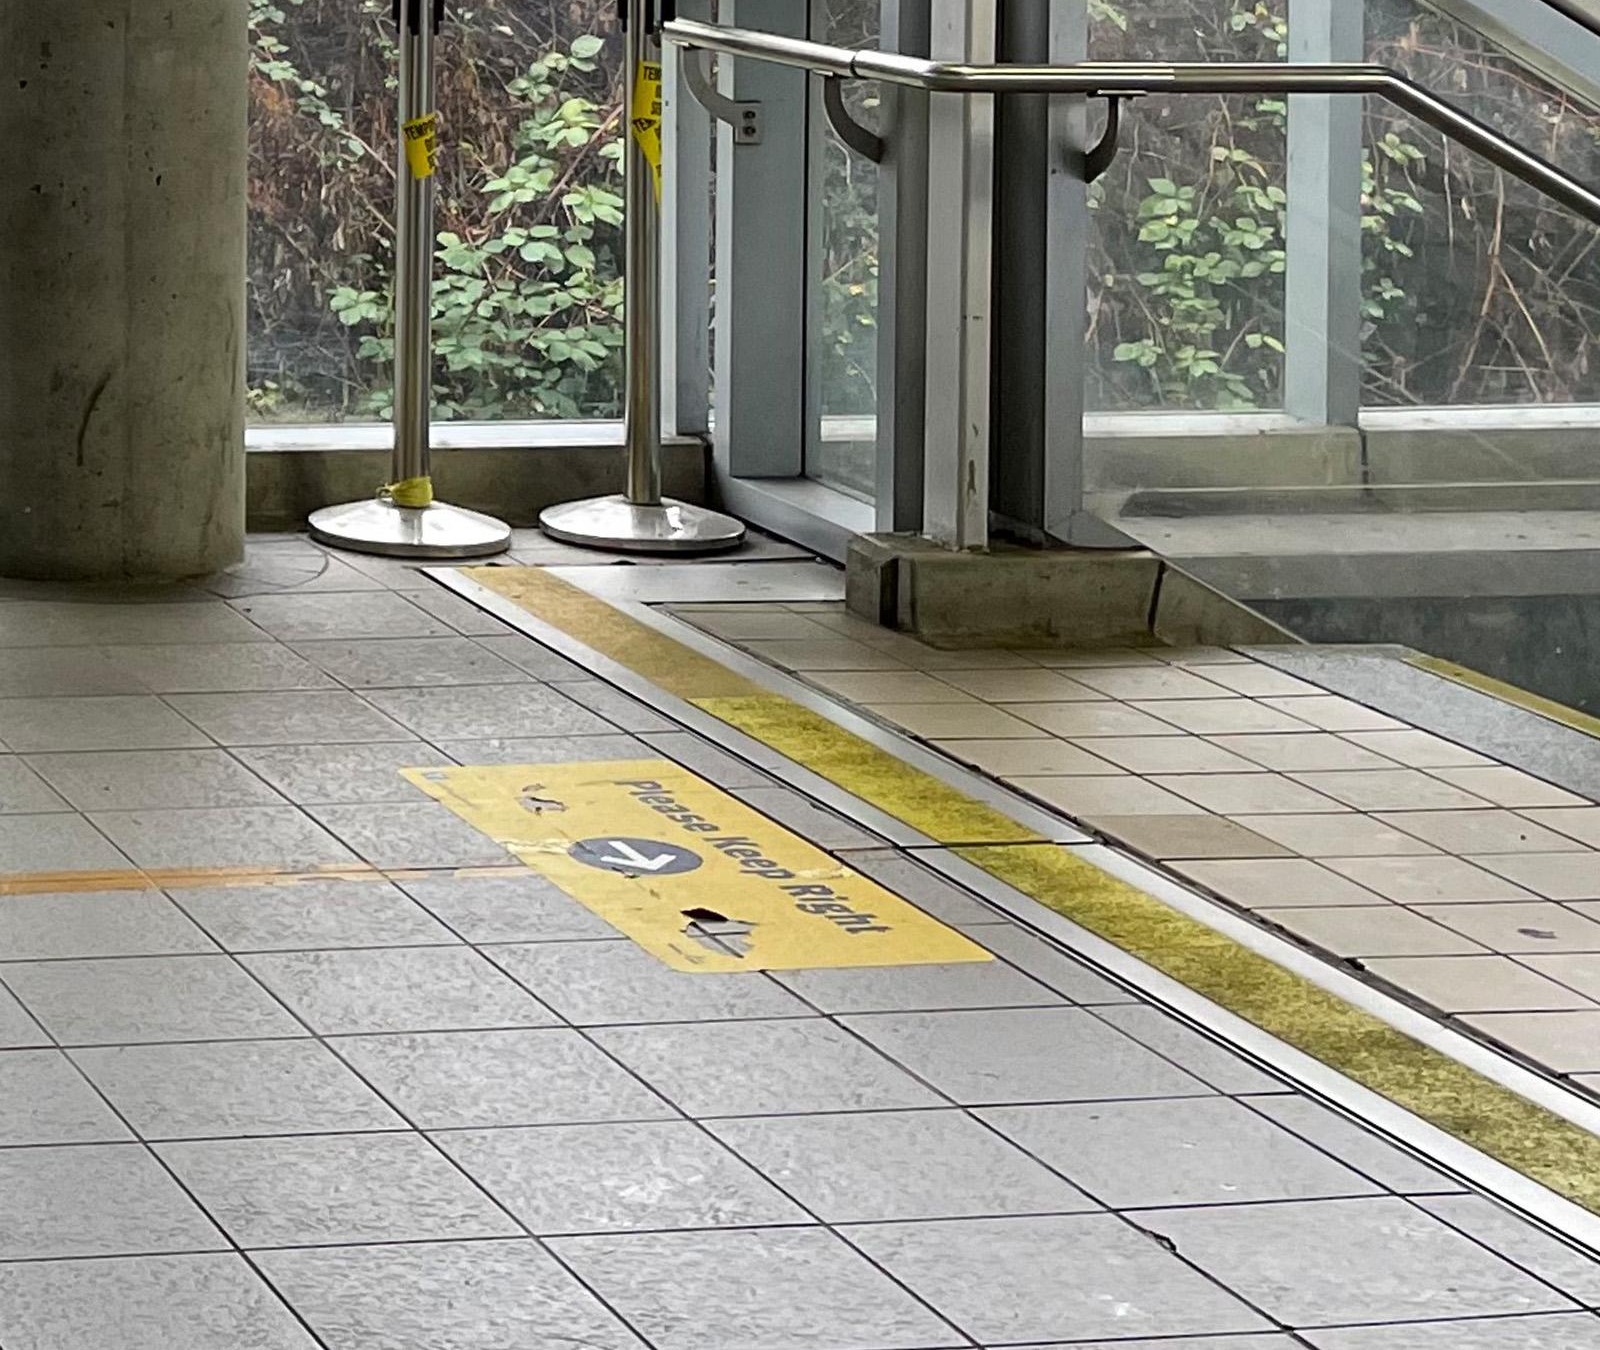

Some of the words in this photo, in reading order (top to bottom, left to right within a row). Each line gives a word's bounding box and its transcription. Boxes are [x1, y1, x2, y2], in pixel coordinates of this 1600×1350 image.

[613, 779, 722, 833] Please
[702, 835, 796, 880] Keep
[778, 883, 894, 935] Right
